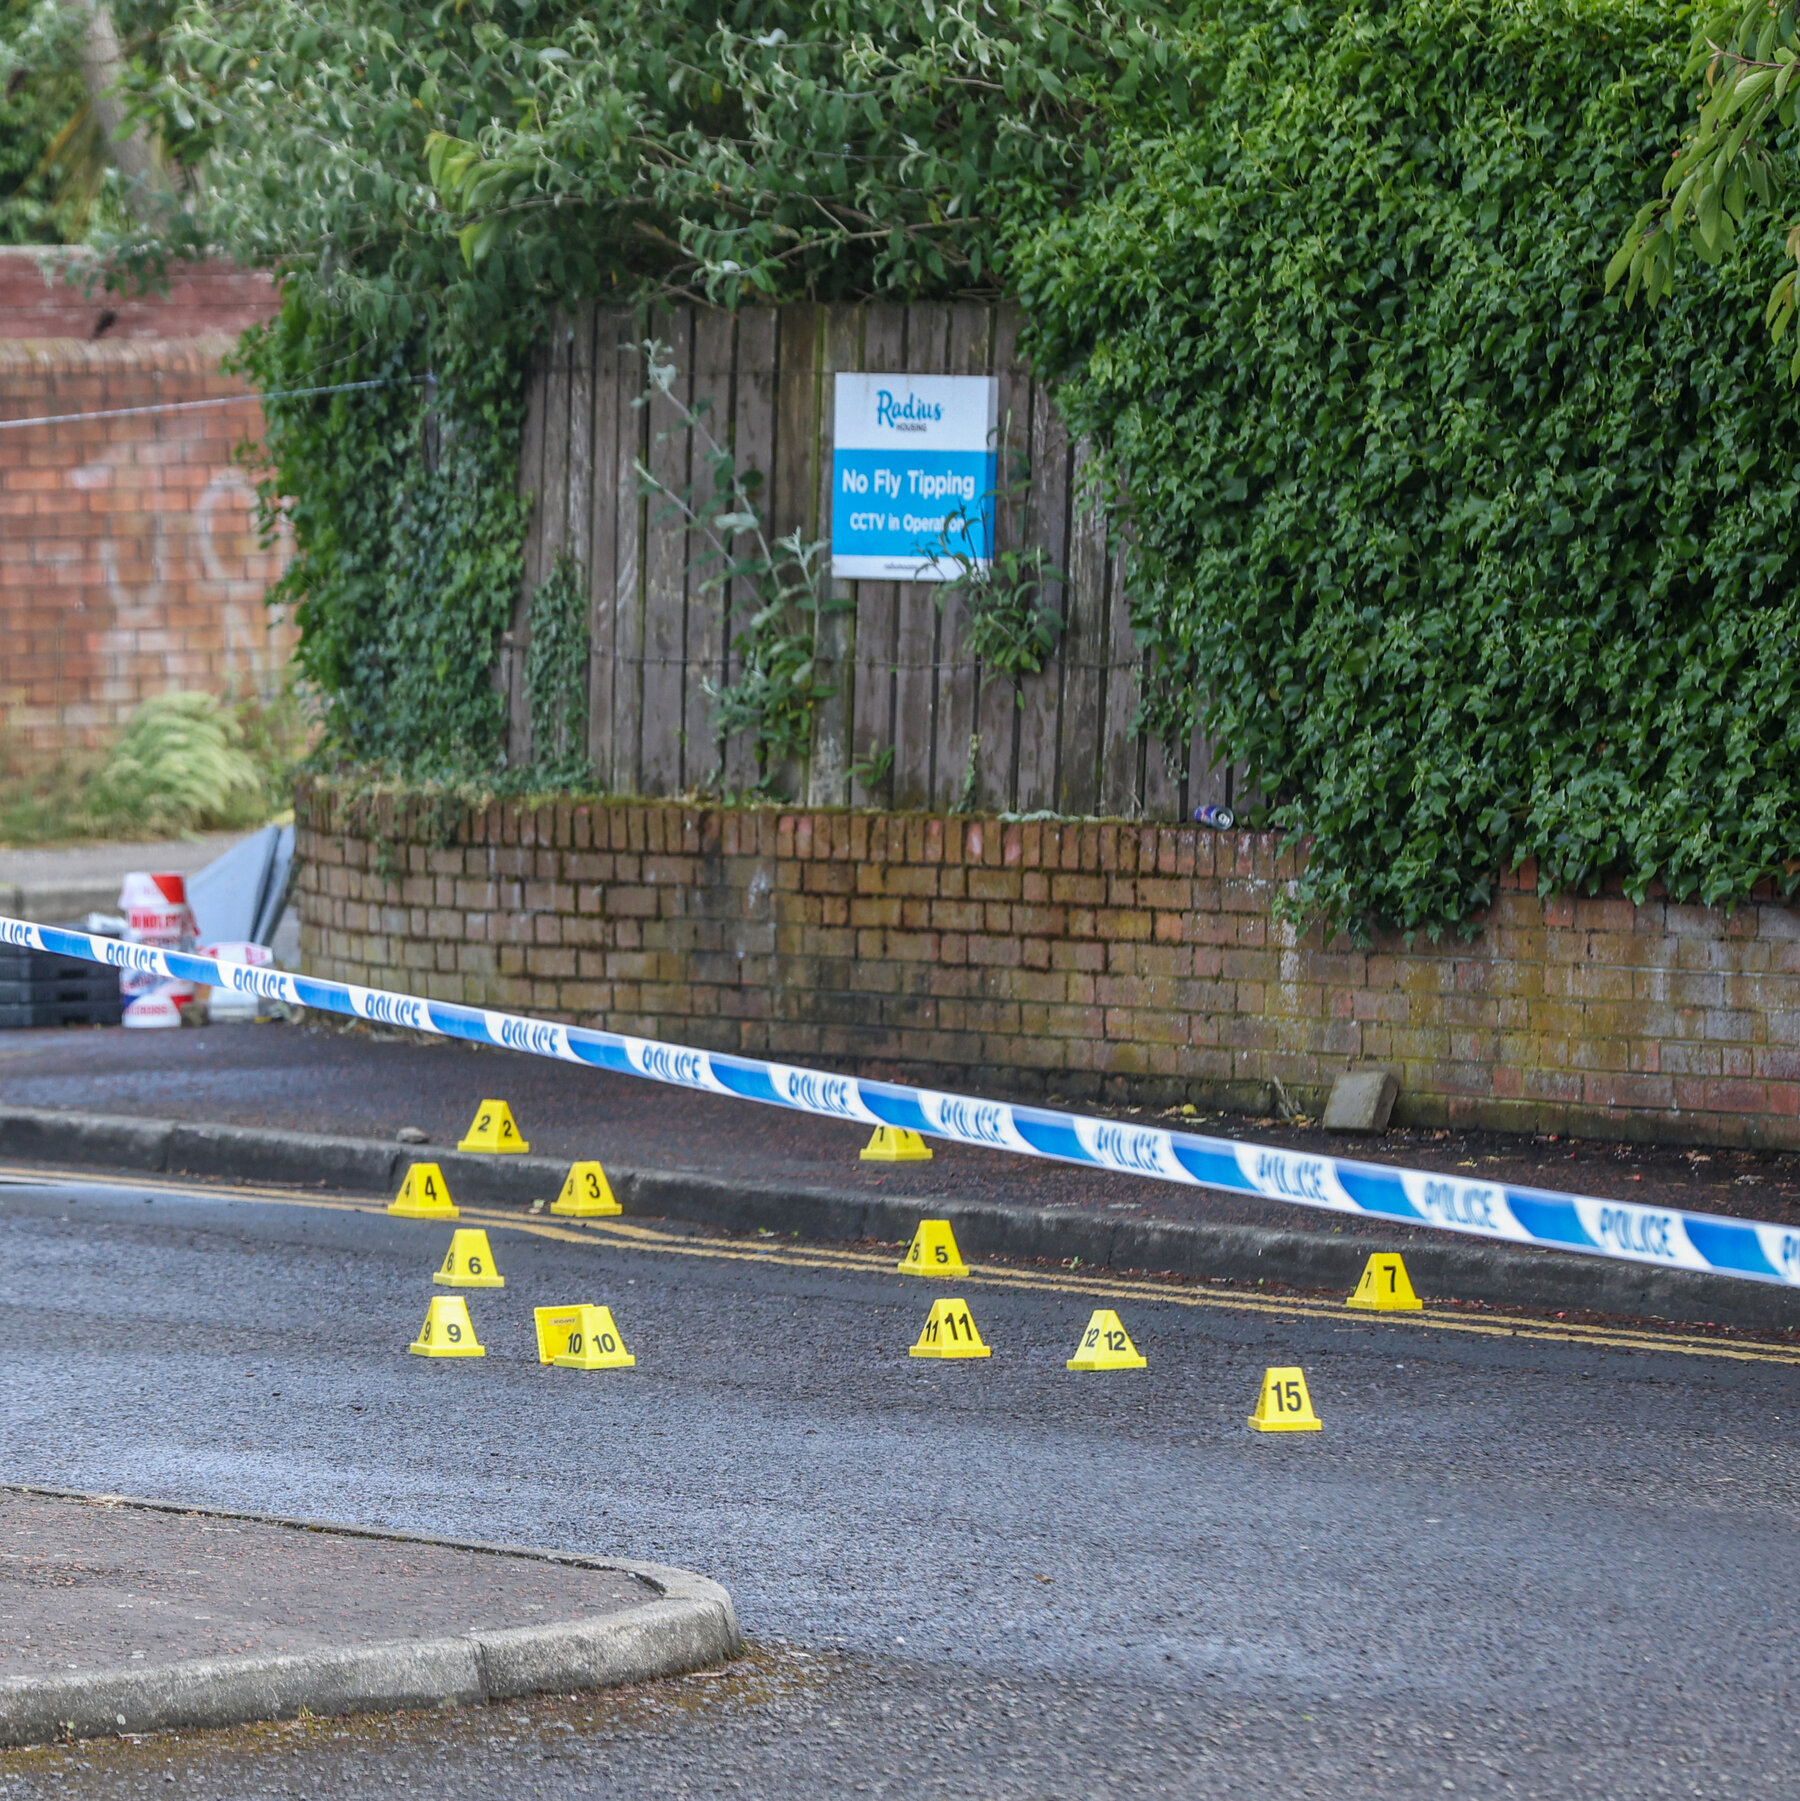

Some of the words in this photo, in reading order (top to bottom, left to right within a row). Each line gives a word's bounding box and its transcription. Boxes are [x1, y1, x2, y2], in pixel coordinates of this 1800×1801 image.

[877, 389, 943, 428] Radius
[842, 468, 869, 494] No
[874, 468, 902, 499] Fly
[907, 469, 976, 501] Tipping
[850, 512, 886, 531] CCTV
[888, 512, 901, 531] in
[903, 513, 966, 535] Operaton
[0, 921, 33, 948] LICE
[106, 942, 158, 973] POLICE
[233, 967, 287, 1001] POLICE
[365, 992, 422, 1026] POLICE
[501, 1018, 559, 1052] POLICE
[642, 1044, 704, 1084] POLICE
[788, 1071, 855, 1115] POLICE
[478, 1114, 491, 1132] 2
[502, 1120, 513, 1137] 2
[940, 1097, 1008, 1144] POLICE
[879, 1126, 885, 1142] 1
[1096, 1125, 1164, 1173] POLICE
[404, 1181, 411, 1199] 4
[424, 1175, 437, 1201] 4
[567, 1178, 574, 1196] 3
[585, 1173, 600, 1199] 3
[1257, 1152, 1328, 1202] POLICE
[1424, 1180, 1497, 1229] POLICE
[1599, 1206, 1674, 1257] POLICE
[446, 1252, 454, 1272] 6
[912, 1242, 920, 1261] 5
[935, 1245, 948, 1263] 5
[468, 1256, 482, 1275] 6
[1366, 1271, 1372, 1289] 7
[1383, 1265, 1397, 1293] 7
[423, 1321, 431, 1341] 9
[446, 1323, 462, 1343] 9
[925, 1319, 939, 1342] 11
[944, 1312, 974, 1341] 11
[1085, 1328, 1100, 1348] 12
[568, 1332, 583, 1354] 10
[592, 1333, 616, 1354] 10
[1103, 1330, 1127, 1351] 12
[1271, 1381, 1302, 1412] 15
